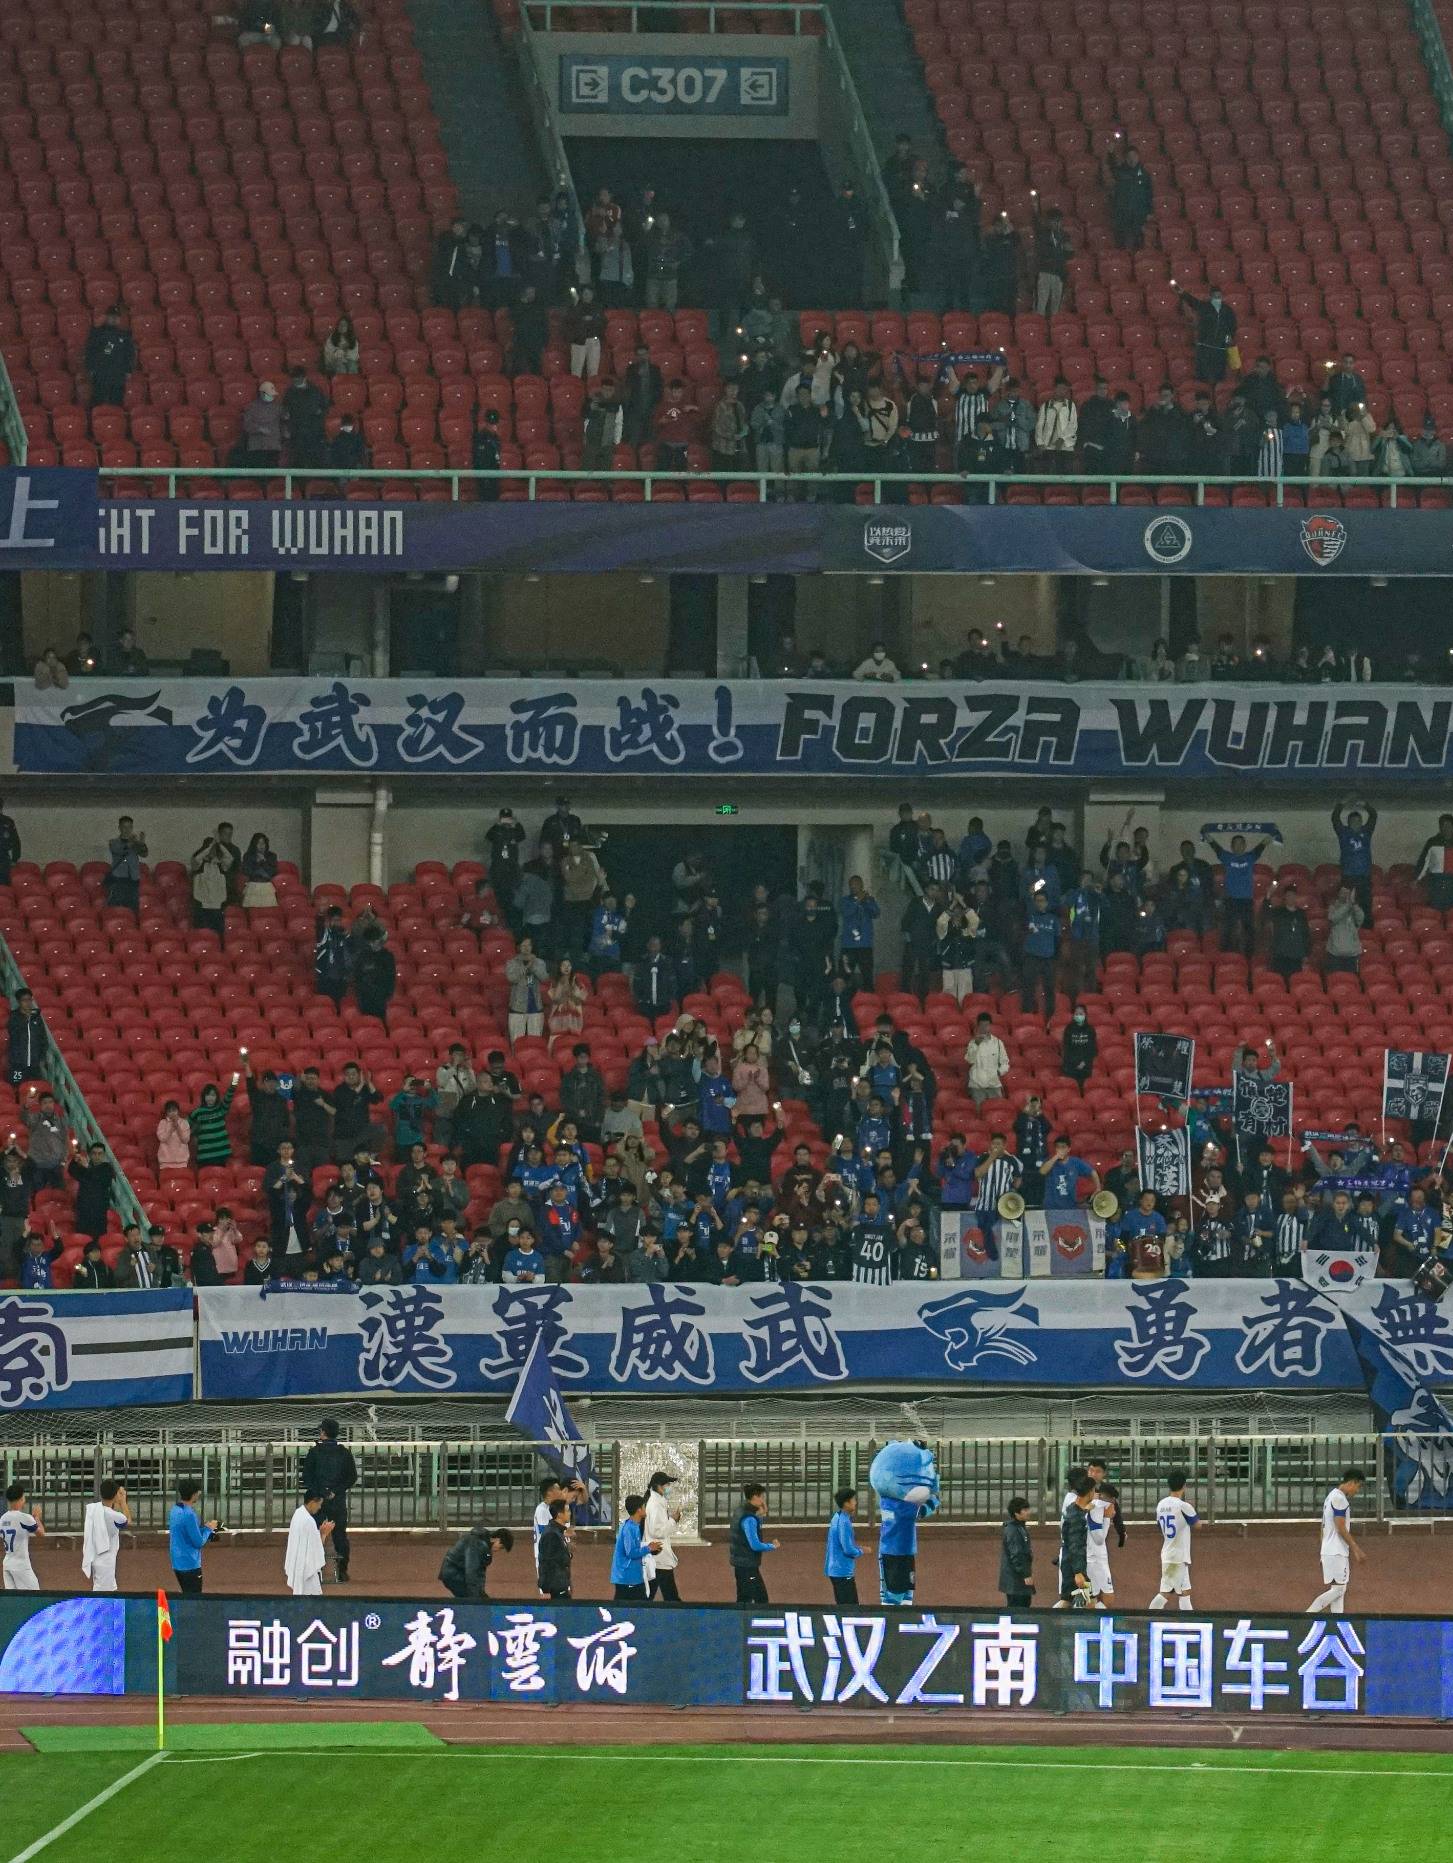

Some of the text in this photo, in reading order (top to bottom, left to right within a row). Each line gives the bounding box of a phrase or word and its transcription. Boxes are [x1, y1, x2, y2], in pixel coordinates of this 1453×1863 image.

[621, 66, 728, 104] C307
[178, 509, 249, 554] FOR
[272, 509, 403, 555] WUHAN
[777, 692, 1081, 767] FORZA
[1109, 697, 1453, 770] WUHAN
[860, 1240, 884, 1262] 40
[220, 1326, 328, 1354] WUHAN
[227, 1618, 360, 1687] 融创
[746, 1611, 1365, 1710] 武汉之南 中国车谷
